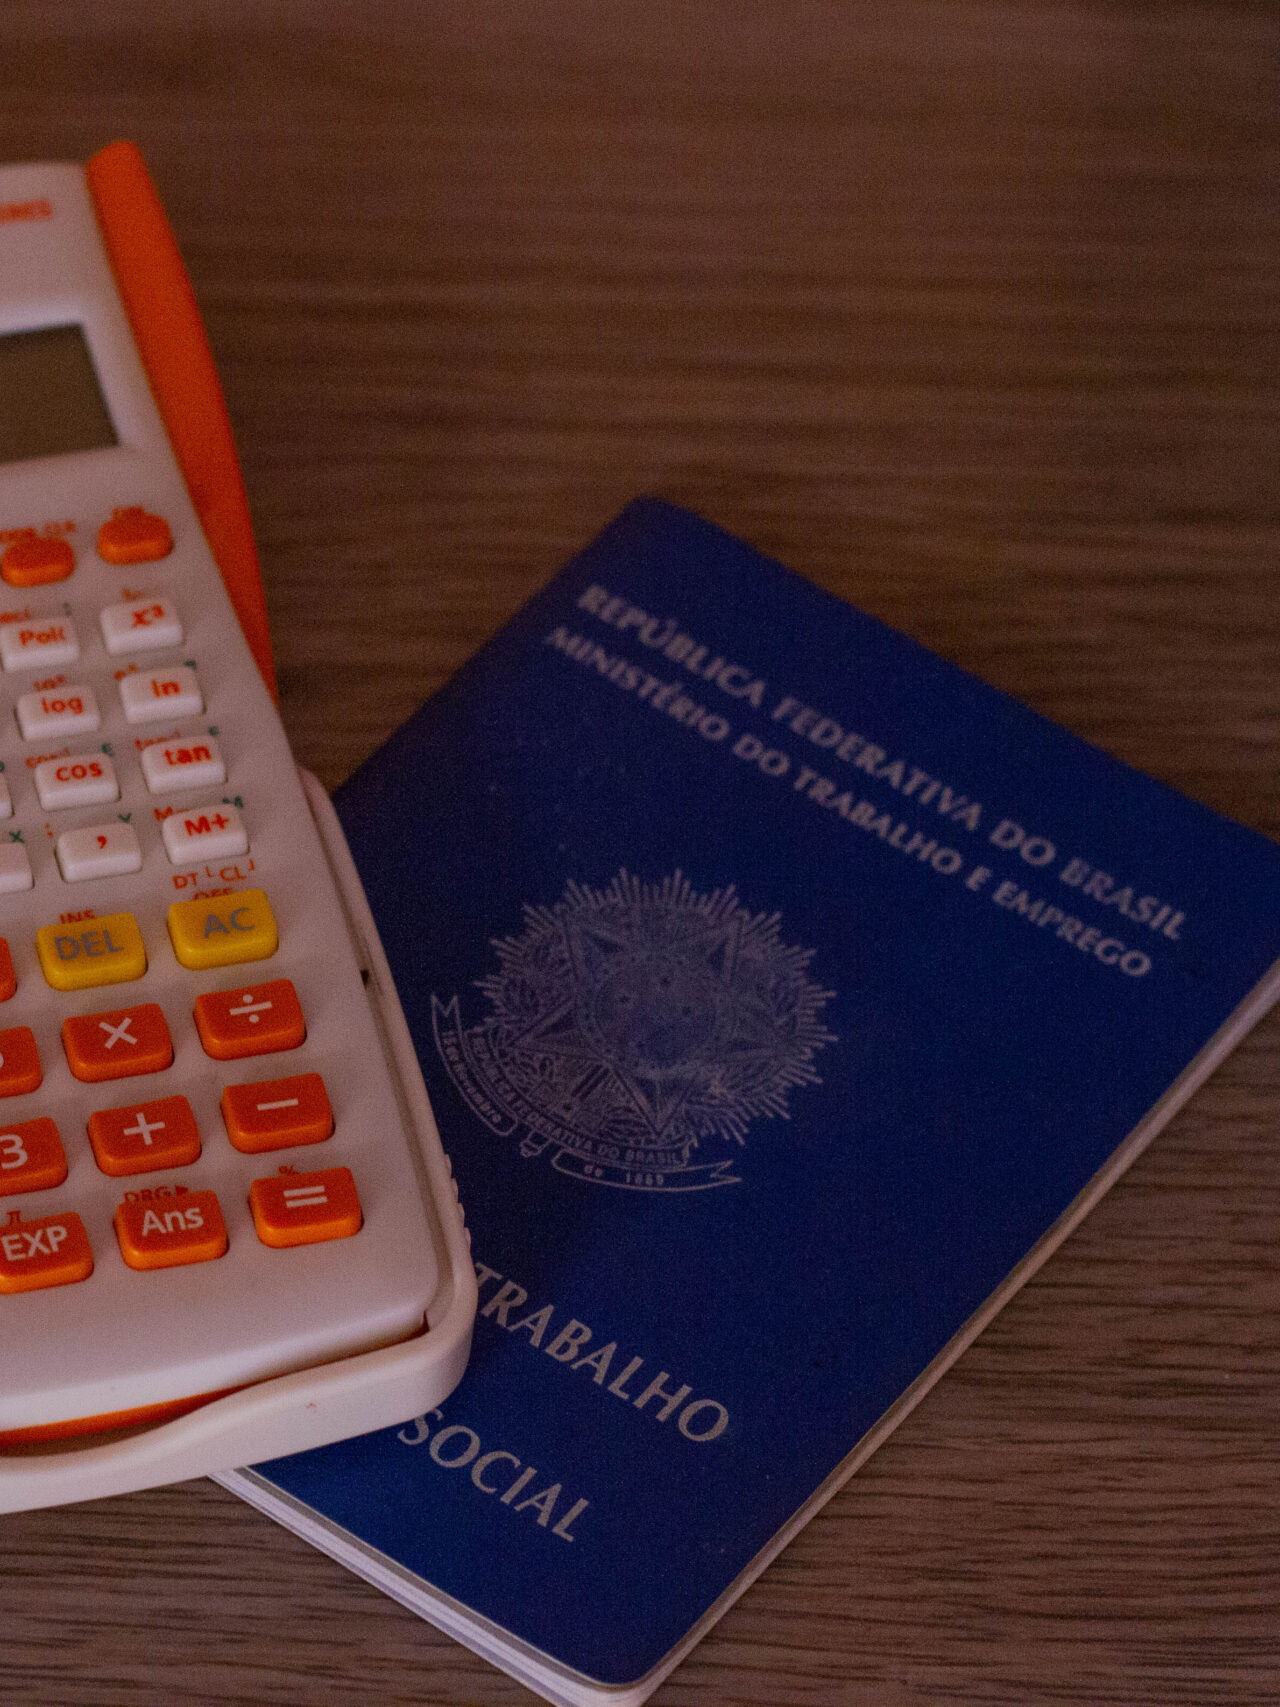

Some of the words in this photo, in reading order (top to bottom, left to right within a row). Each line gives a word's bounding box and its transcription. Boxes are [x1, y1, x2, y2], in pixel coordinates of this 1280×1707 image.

[151, 679, 181, 698] ln
[41, 696, 84, 715] log
[163, 744, 212, 766] tan
[578, 584, 766, 708] REPÚBLICA
[773, 696, 983, 832] FEDERATIVA
[989, 817, 1056, 866] DO
[1060, 856, 1186, 941] BRASIL
[55, 761, 104, 783] cos
[184, 812, 230, 836] M+
[733, 733, 791, 777] DO
[795, 764, 962, 875] TRABALHO
[966, 865, 993, 891] E
[991, 878, 1152, 977] EMPREGO
[203, 907, 256, 938] AC
[54, 929, 125, 961] DEL
[141, 1206, 204, 1237] Ans
[0, 1225, 68, 1262] EXP
[474, 1261, 730, 1443] TRABALHO
[397, 1407, 590, 1543] SOCIAL
